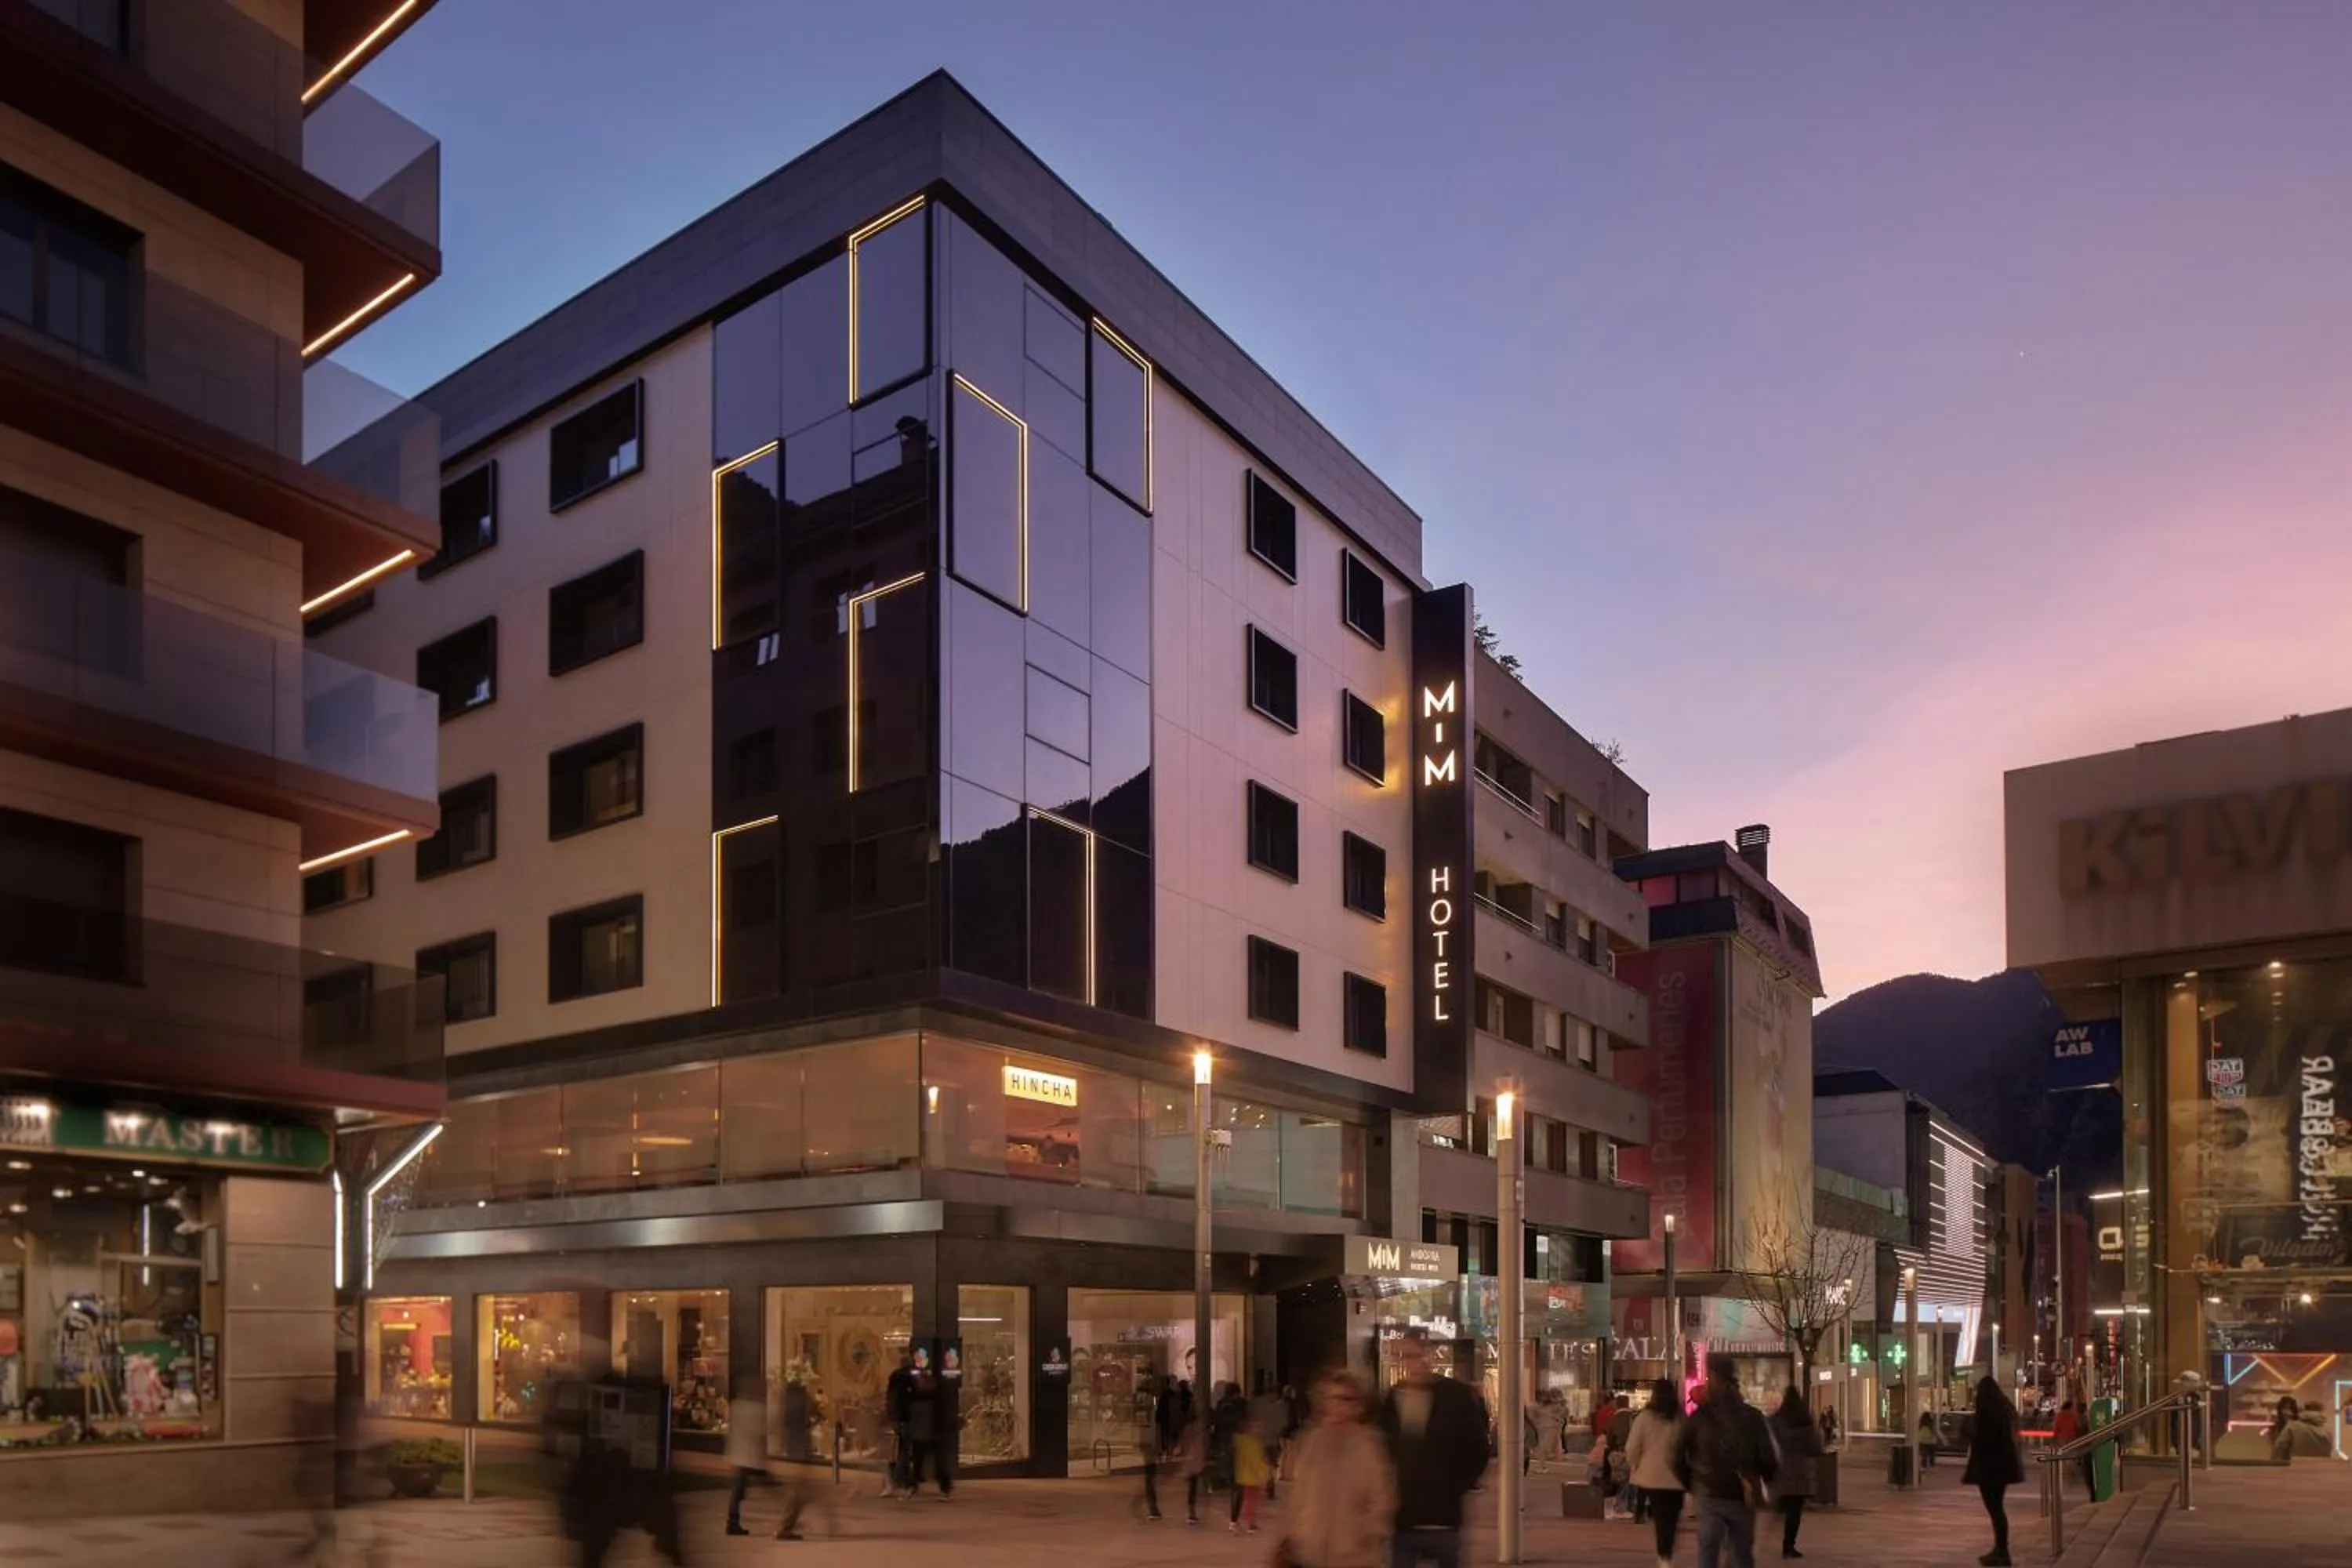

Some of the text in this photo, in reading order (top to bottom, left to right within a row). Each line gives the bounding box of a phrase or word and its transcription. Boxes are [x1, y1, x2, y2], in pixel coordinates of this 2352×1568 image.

[1429, 866, 1453, 1022] HOTEL
[2055, 1026, 2090, 1043] AW
[2054, 1041, 2094, 1058] LAB
[1011, 1073, 1073, 1101] HINCHA
[103, 1110, 295, 1159] MASTER
